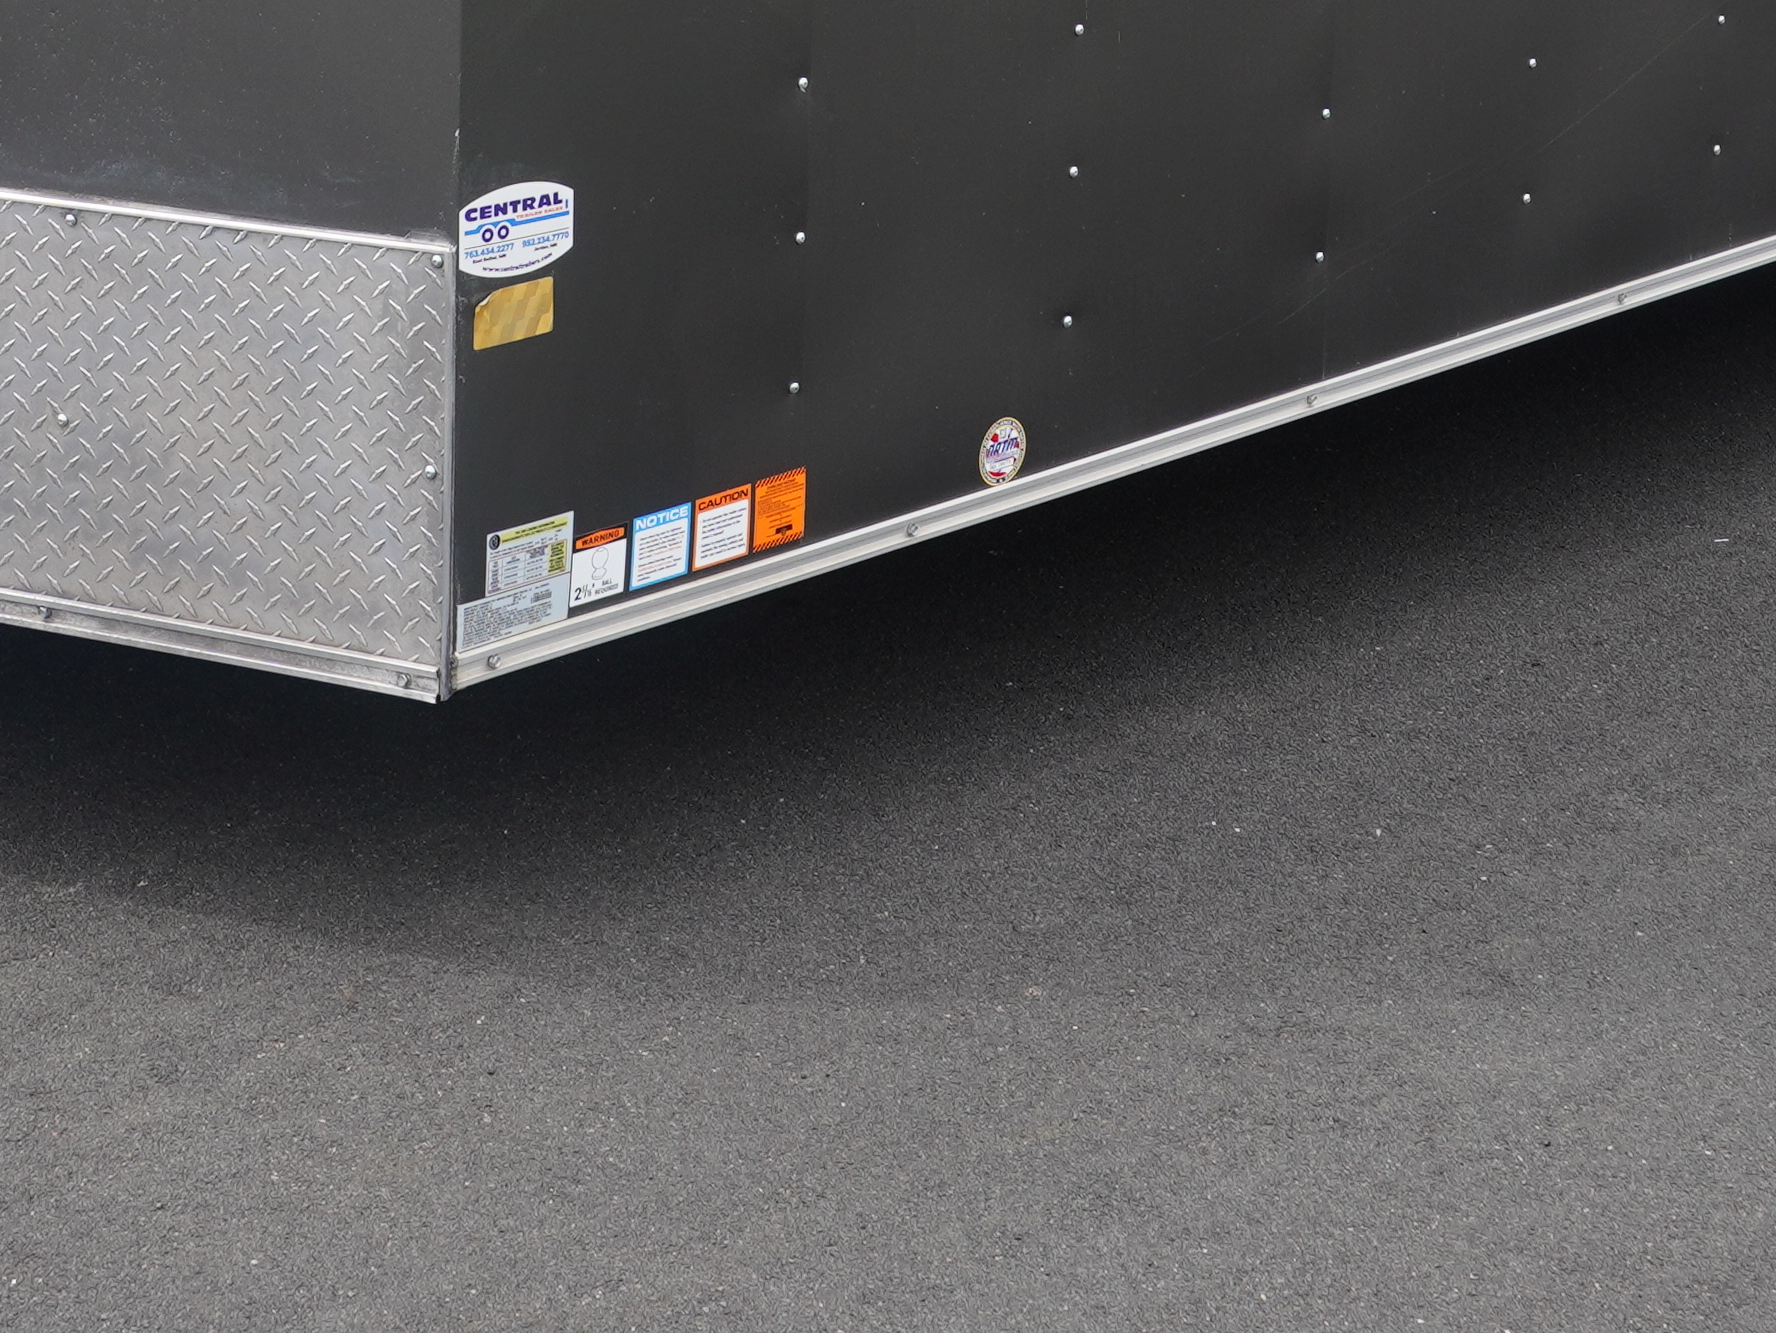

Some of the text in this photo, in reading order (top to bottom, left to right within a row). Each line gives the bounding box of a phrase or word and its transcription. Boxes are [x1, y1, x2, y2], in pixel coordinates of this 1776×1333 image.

[464, 192, 563, 223] CENTRAL
[698, 488, 749, 511] CAUTION
[635, 505, 689, 531] NOTICE
[581, 529, 620, 547] WARNING
